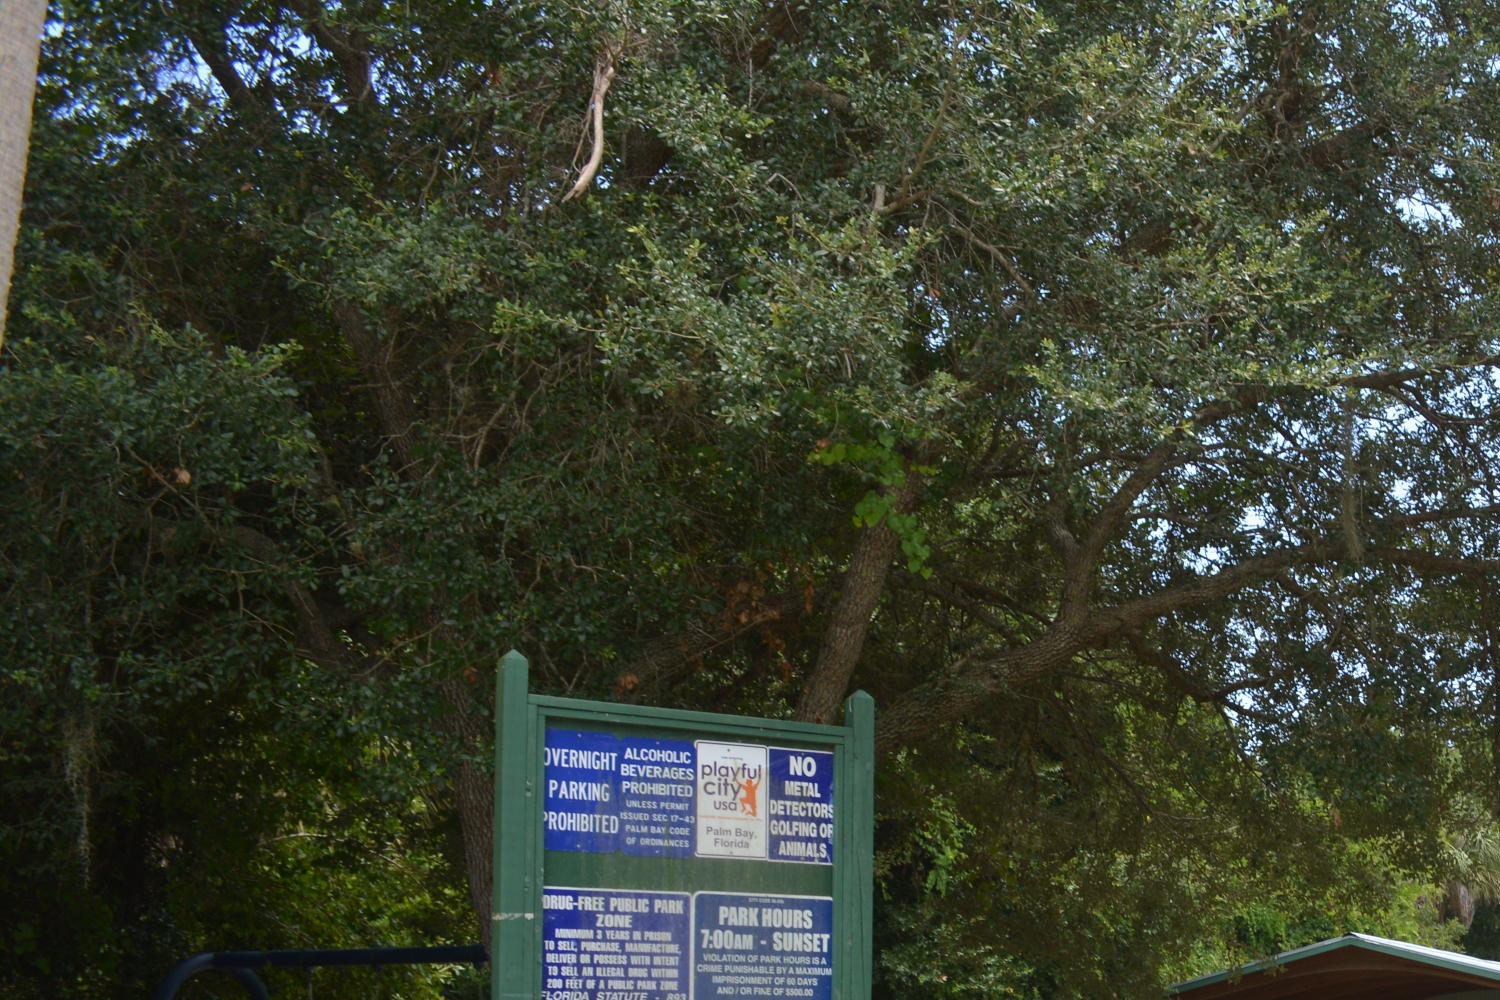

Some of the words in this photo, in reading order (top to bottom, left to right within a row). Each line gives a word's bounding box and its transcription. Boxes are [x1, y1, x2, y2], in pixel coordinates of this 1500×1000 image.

[624, 747, 691, 764] ALCOHOLIC
[620, 763, 694, 781] BEVERAGES
[701, 761, 762, 781] playful
[789, 755, 817, 777] NO
[548, 780, 610, 802] PARKING
[622, 781, 693, 797] PROHIBITED
[703, 778, 742, 801] city
[784, 781, 821, 798] METAL
[626, 800, 657, 809] UNLESS
[660, 802, 690, 811] PERMIT
[713, 800, 738, 811] usa
[770, 800, 833, 818] DETECTORS
[620, 812, 650, 821] ISSUED
[652, 813, 668, 822] SEC
[625, 824, 649, 833] PALM
[650, 825, 666, 834] BAY
[669, 827, 691, 835] CODE
[706, 826, 732, 837] Palm
[770, 820, 817, 837] GOLFING
[626, 837, 636, 845] OF
[639, 838, 690, 848] ORDINANCES
[713, 838, 750, 849] Florida
[778, 840, 827, 858] ANIMALS
[543, 895, 605, 911] DRUG-FREE
[609, 897, 649, 913] PUBLIC
[654, 899, 684, 914] PARK
[595, 914, 632, 928] ZONE
[719, 906, 759, 927] PARK
[762, 907, 813, 929] HOURS
[555, 928, 594, 939] MINIMUM
[596, 930, 602, 940] 3
[605, 930, 630, 940] YEARS
[632, 931, 642, 940] IN
[644, 931, 672, 942] PRISON
[701, 929, 753, 950] 7:00AM
[773, 932, 830, 953] SUNSET
[544, 940, 555, 950] TO
[546, 953, 577, 963] DELIVER
[580, 954, 590, 964] OR
[593, 954, 627, 965] POSSESS
[630, 955, 650, 965] WITH
[653, 956, 679, 966] INTENT
[703, 953, 745, 962] VIOLATION
[748, 955, 758, 963] OF
[760, 955, 781, 963] PARK
[783, 956, 810, 965] HOURS
[812, 957, 819, 965] IS
[820, 957, 827, 965] A
[548, 966, 558, 976] TO
[561, 966, 579, 977] SELL
[582, 967, 594, 977] AN
[596, 967, 625, 977] ILLEGAL
[628, 967, 648, 978] DRUG
[651, 968, 679, 978] WITHIN
[697, 964, 722, 973] CRIME
[724, 965, 775, 974] PUNISHABLE
[776, 966, 787, 975] BY
[788, 967, 795, 975] A
[796, 967, 832, 976] MAXIMUM
[547, 978, 562, 989] 200
[565, 979, 583, 989] FEET
[586, 979, 596, 989] OF
[599, 979, 605, 989] A
[607, 980, 634, 990] PUBLIC
[637, 980, 657, 990] PARK
[660, 981, 678, 991] ZONE
[712, 976, 772, 985] IMPRISONMENT
[774, 977, 785, 985] OF
[798, 978, 818, 986] DAYS
[541, 991, 589, 1000] FLORIDA
[717, 986, 735, 995] AND
[740, 987, 752, 995] OR
[754, 987, 772, 996] FINE
[773, 988, 784, 996] OF
